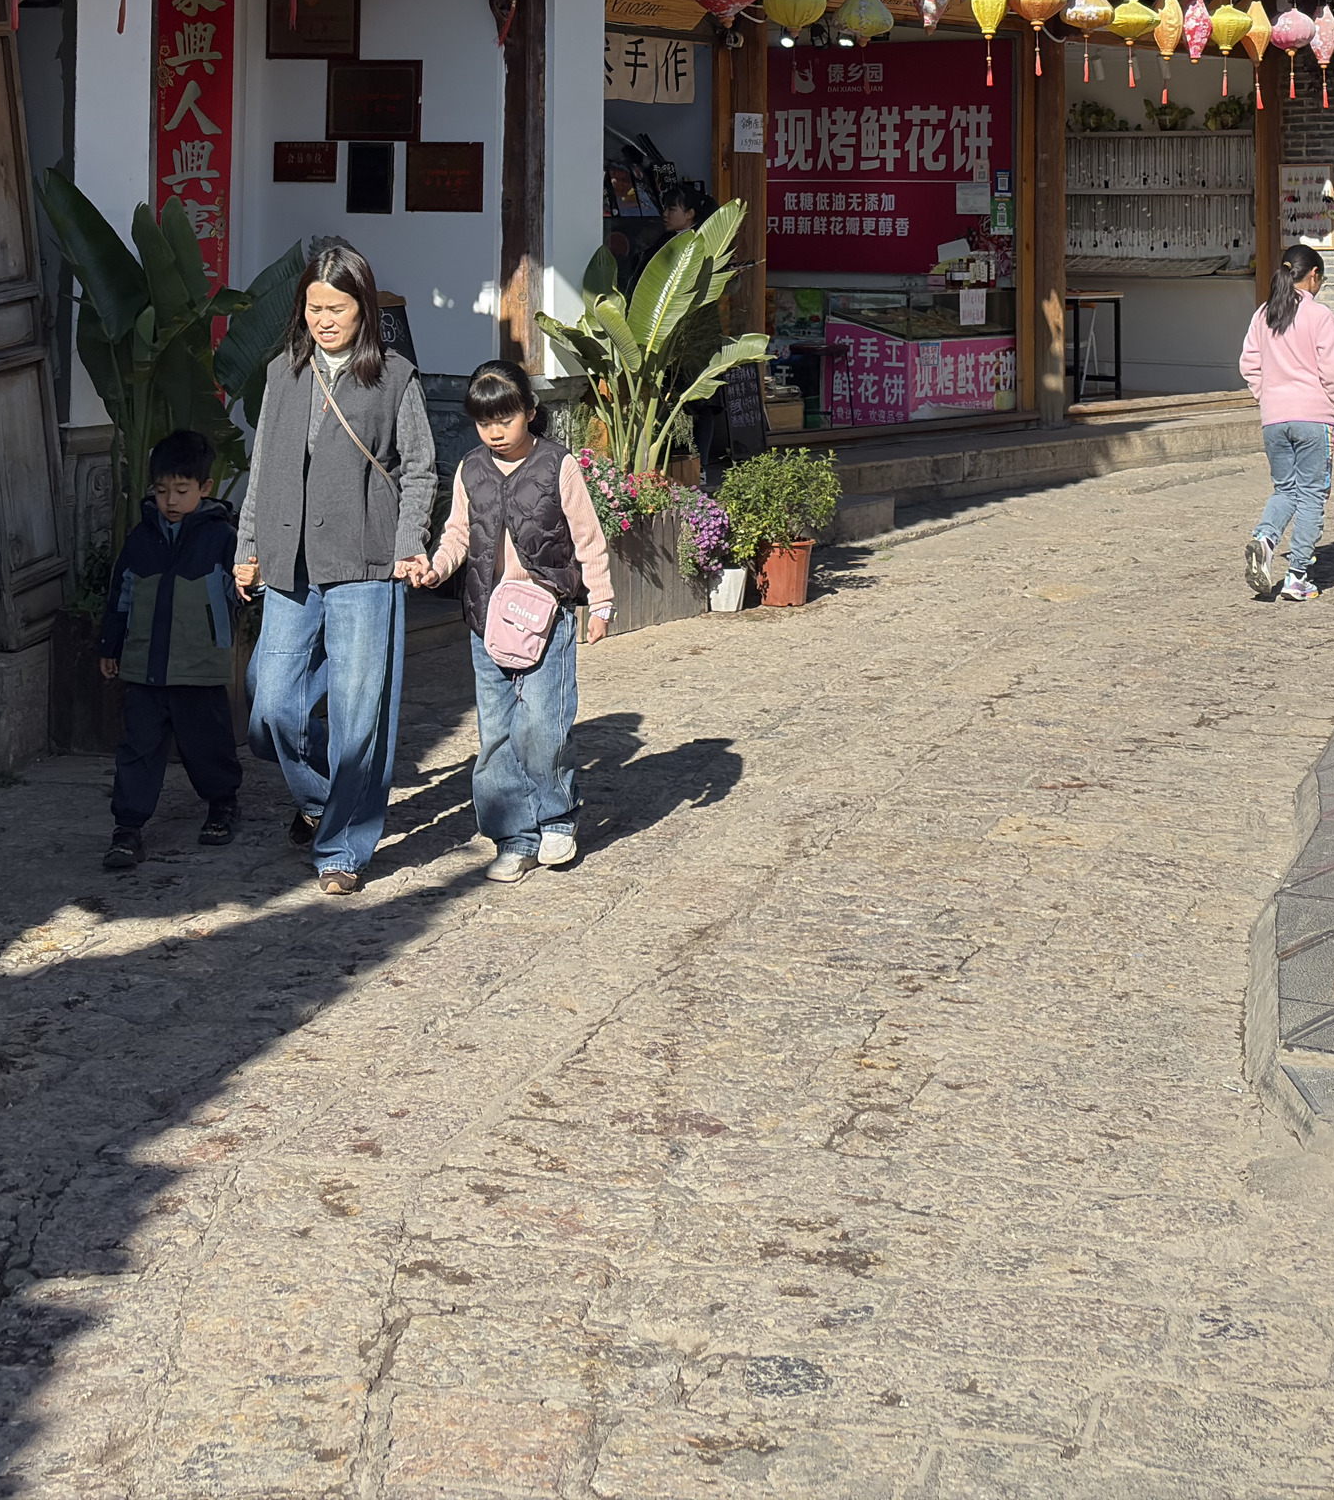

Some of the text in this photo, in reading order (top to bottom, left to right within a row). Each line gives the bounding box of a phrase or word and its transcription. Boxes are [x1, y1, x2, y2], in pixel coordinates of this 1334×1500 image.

[767, 105, 993, 172] 现烤鲜花饼
[784, 192, 896, 212] 低糖低油无添加
[767, 216, 910, 237] 只用新鲜花瓣更醇香
[833, 370, 906, 406] 鲜花饼
[507, 601, 540, 623] China
